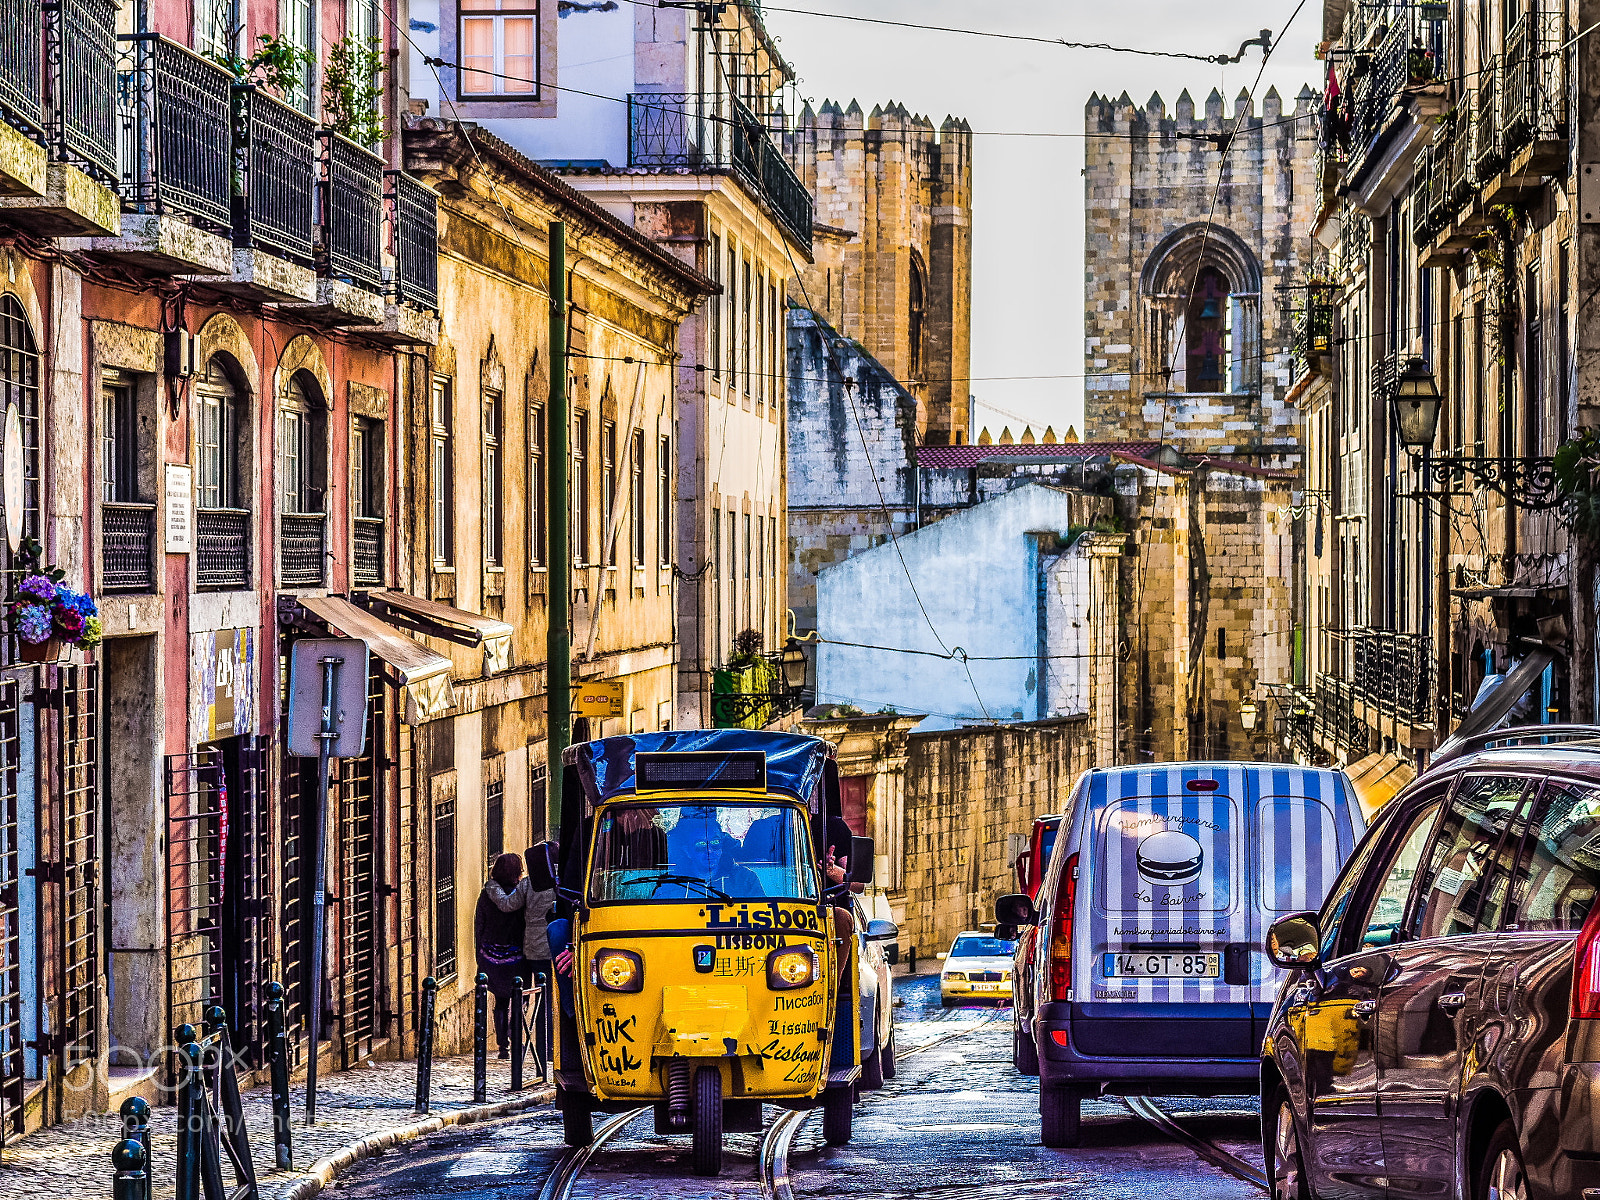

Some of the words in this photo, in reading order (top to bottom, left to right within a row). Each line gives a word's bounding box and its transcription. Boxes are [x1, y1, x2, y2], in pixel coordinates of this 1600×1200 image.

[706, 902, 818, 931] Lisboa
[715, 934, 788, 951] LISBONA
[774, 990, 824, 1012] Лиссабон
